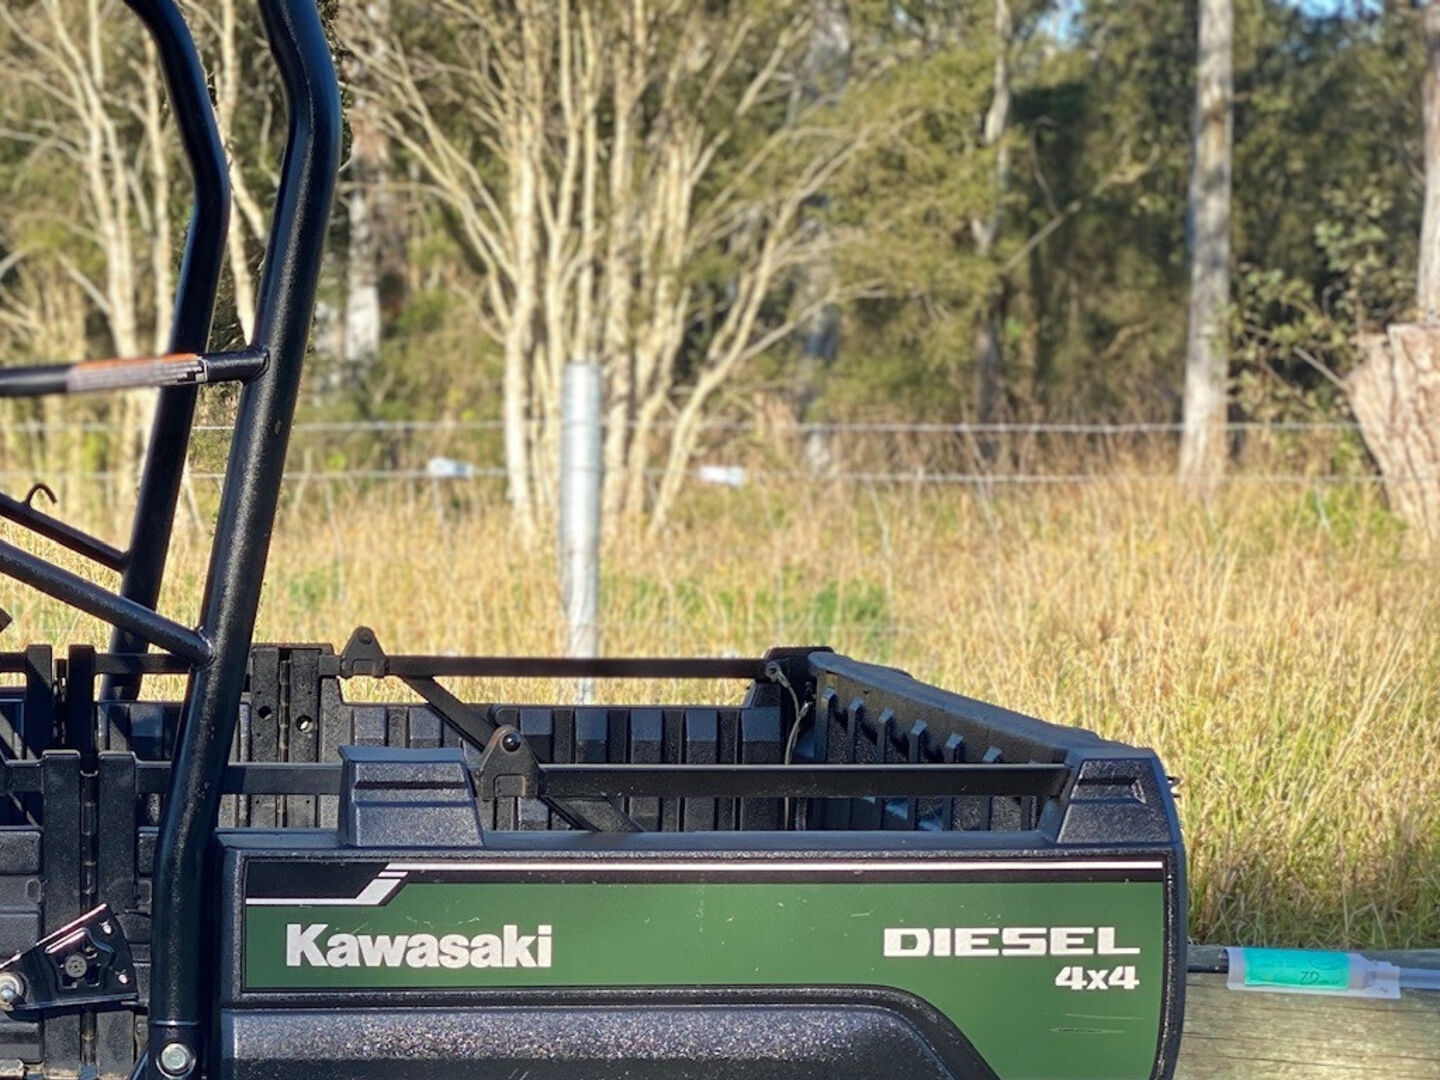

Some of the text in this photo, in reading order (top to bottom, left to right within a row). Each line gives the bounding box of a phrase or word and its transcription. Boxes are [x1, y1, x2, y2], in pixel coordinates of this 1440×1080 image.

[286, 924, 553, 968] Kawasaki
[883, 926, 1141, 957] DIESEL
[1055, 966, 1140, 990] 4x4
